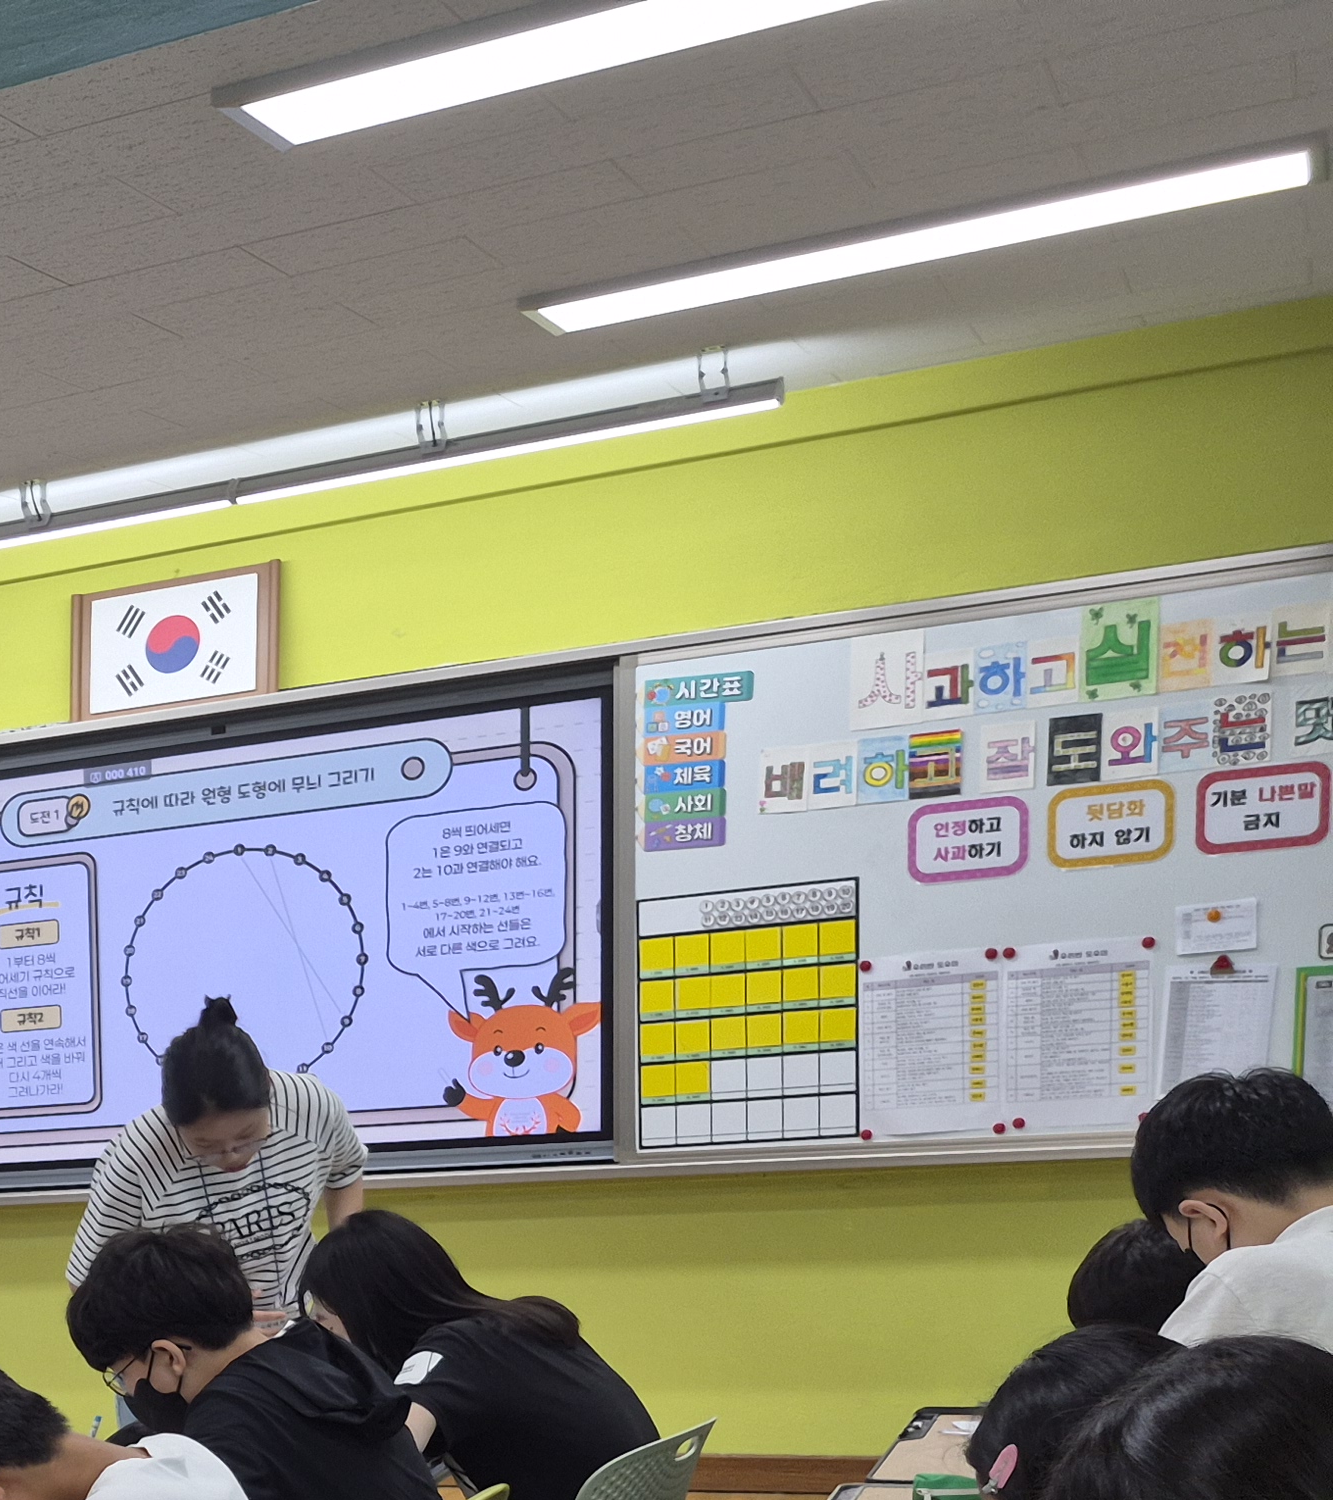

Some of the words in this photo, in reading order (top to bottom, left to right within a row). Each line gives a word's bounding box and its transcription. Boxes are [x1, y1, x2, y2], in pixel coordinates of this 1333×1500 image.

[675, 676, 742, 700] 시간표
[858, 651, 1075, 709] 사과하고
[674, 708, 712, 728] 영어
[674, 737, 712, 756] 국어
[764, 747, 956, 800] 배려하고
[986, 737, 1036, 780] 잘
[1051, 713, 1266, 772] 도와주는
[105, 767, 124, 780] 000
[127, 765, 146, 778] 410
[673, 765, 711, 785] 체육
[113, 795, 158, 817] 규칙에
[164, 791, 196, 809] 따라
[201, 785, 232, 806] 원형
[237, 778, 286, 801] 도형에
[291, 774, 322, 793] 무늬
[328, 767, 375, 789] 그리기
[1210, 789, 1248, 808] 기분
[1258, 781, 1318, 804] 나쁜말
[674, 794, 712, 813] 사회
[1086, 799, 1146, 822] 뒷담화
[30, 810, 51, 825] 도전
[54, 809, 60, 821] 1
[1243, 812, 1281, 831] 금지
[442, 826, 462, 839] 8씩
[465, 821, 511, 837] 띄어세면
[675, 822, 712, 842] 창체
[934, 816, 1002, 839] 인정하고
[1069, 831, 1104, 849] 하지
[1114, 826, 1151, 846] 않기
[433, 846, 451, 859] 1은
[454, 843, 474, 856] 9와
[476, 838, 523, 854] 연결되고
[932, 841, 1002, 862] 사과하기
[413, 866, 433, 879] 2는
[437, 863, 464, 876] 10과
[467, 857, 513, 873] 연결해야
[515, 855, 542, 868] 해요.
[5, 884, 43, 910] 규칙
[15, 927, 40, 941] 규칙1
[423, 926, 445, 939] 에서
[449, 921, 494, 937] 시작하는
[497, 918, 531, 932] 선들은
[415, 945, 437, 957] 서로
[440, 942, 462, 955] 다른
[466, 939, 499, 952] 색으로
[37, 953, 56, 966] 8씩
[33, 966, 75, 981] 규칙으로
[31, 983, 66, 997] 이어라!
[17, 1012, 44, 1026] 규칙2
[7, 1041, 17, 1052] 색
[20, 1039, 41, 1052] 선을
[43, 1036, 86, 1050] 연속해서
[6, 1055, 38, 1068] 그리고
[41, 1052, 61, 1066] 색을
[64, 1051, 86, 1064] 바꿔
[9, 1071, 30, 1083] 다시
[32, 1069, 62, 1081] 4개씩
[8, 1084, 63, 1098] 그려나가라!
